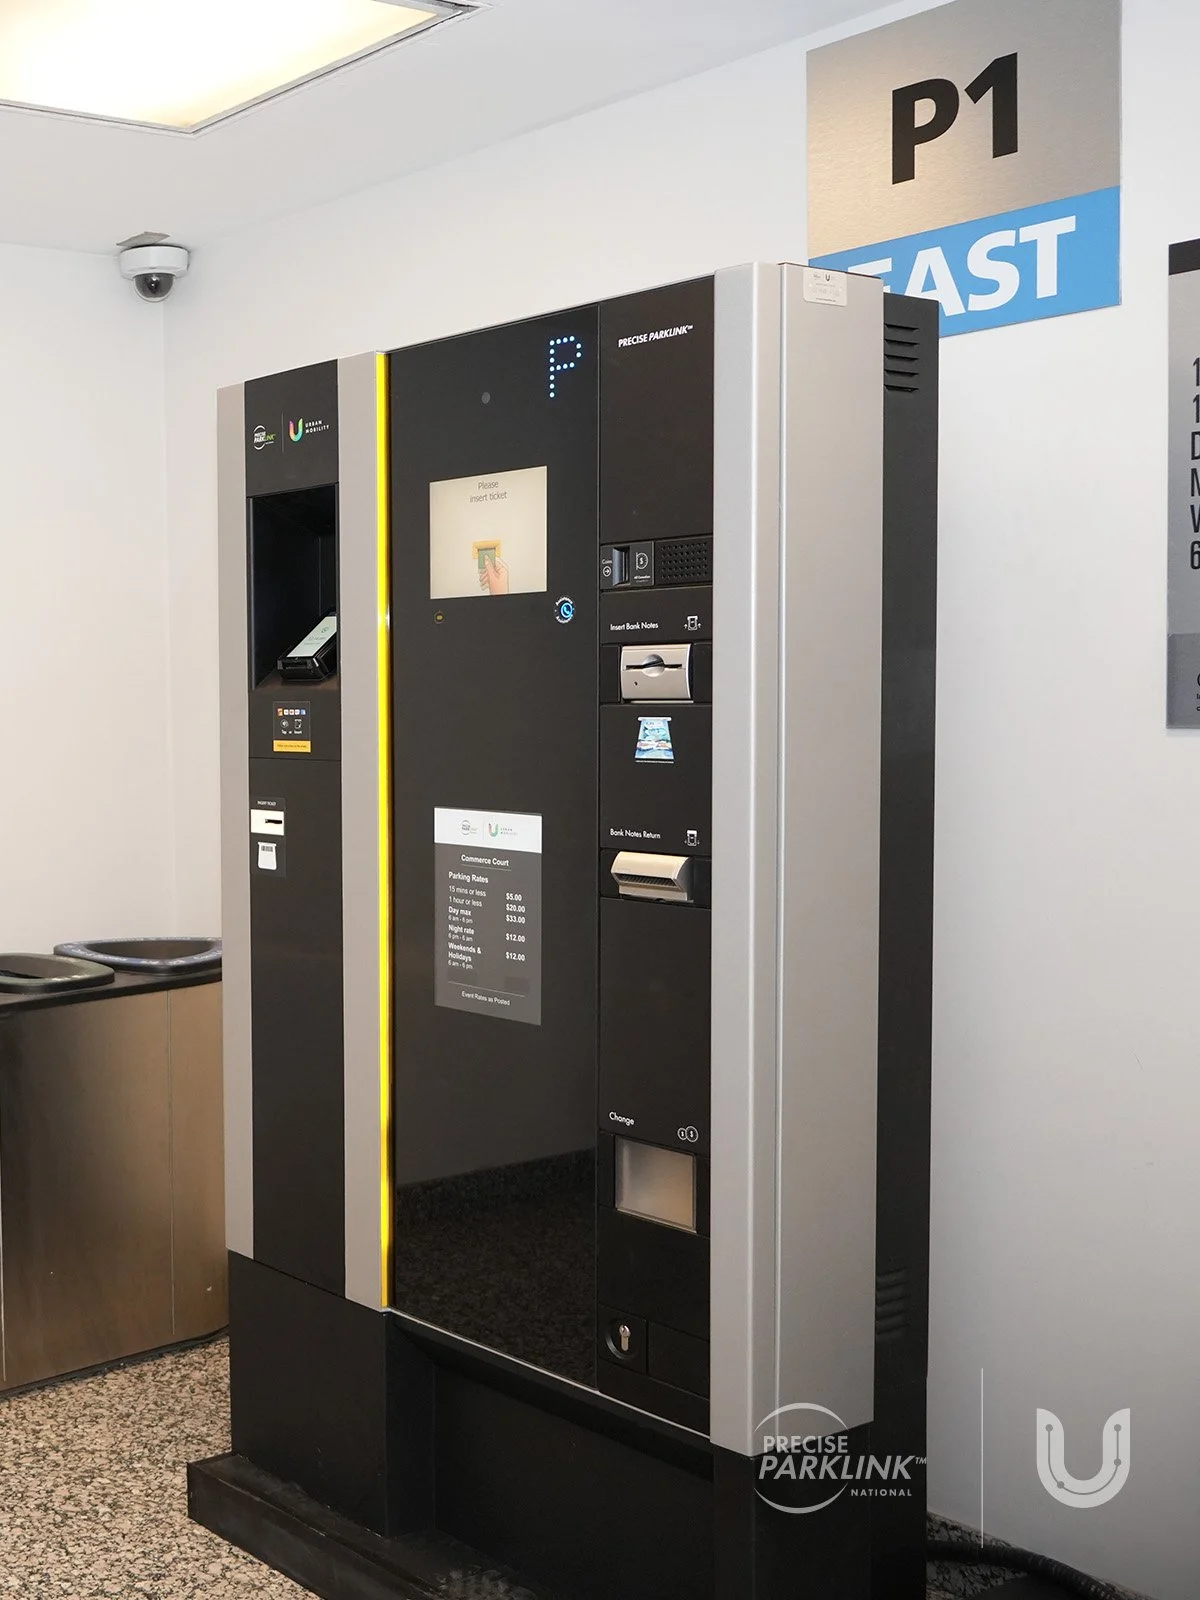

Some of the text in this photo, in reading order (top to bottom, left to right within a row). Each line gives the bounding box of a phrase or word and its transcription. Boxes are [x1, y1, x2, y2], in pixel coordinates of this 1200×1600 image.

[892, 52, 1018, 184] P1
[618, 333, 648, 348] PRECISE
[549, 335, 582, 398] P
[305, 420, 323, 428] URBAN
[305, 424, 330, 434] MOBILITY
[478, 480, 499, 490] Please
[469, 491, 508, 503] insert ticket
[610, 621, 658, 631] Insert Bank Notes
[610, 828, 660, 839] Bank Notes Return
[461, 854, 509, 866] Commerce Court
[448, 871, 489, 883] Parking Rates
[449, 885, 455, 893] 15
[456, 886, 468, 894] mins
[475, 889, 486, 897] less
[506, 892, 522, 901] $5.00
[453, 896, 464, 905] hour
[472, 899, 482, 907] less
[506, 903, 526, 913] $20.00
[448, 906, 526, 924] Day max $33.00
[448, 924, 526, 942] Night rate $12.00
[448, 942, 476, 953] Weekends
[448, 951, 526, 962] Holidays $12.00
[461, 990, 474, 998] Event
[609, 1111, 635, 1126] Change
